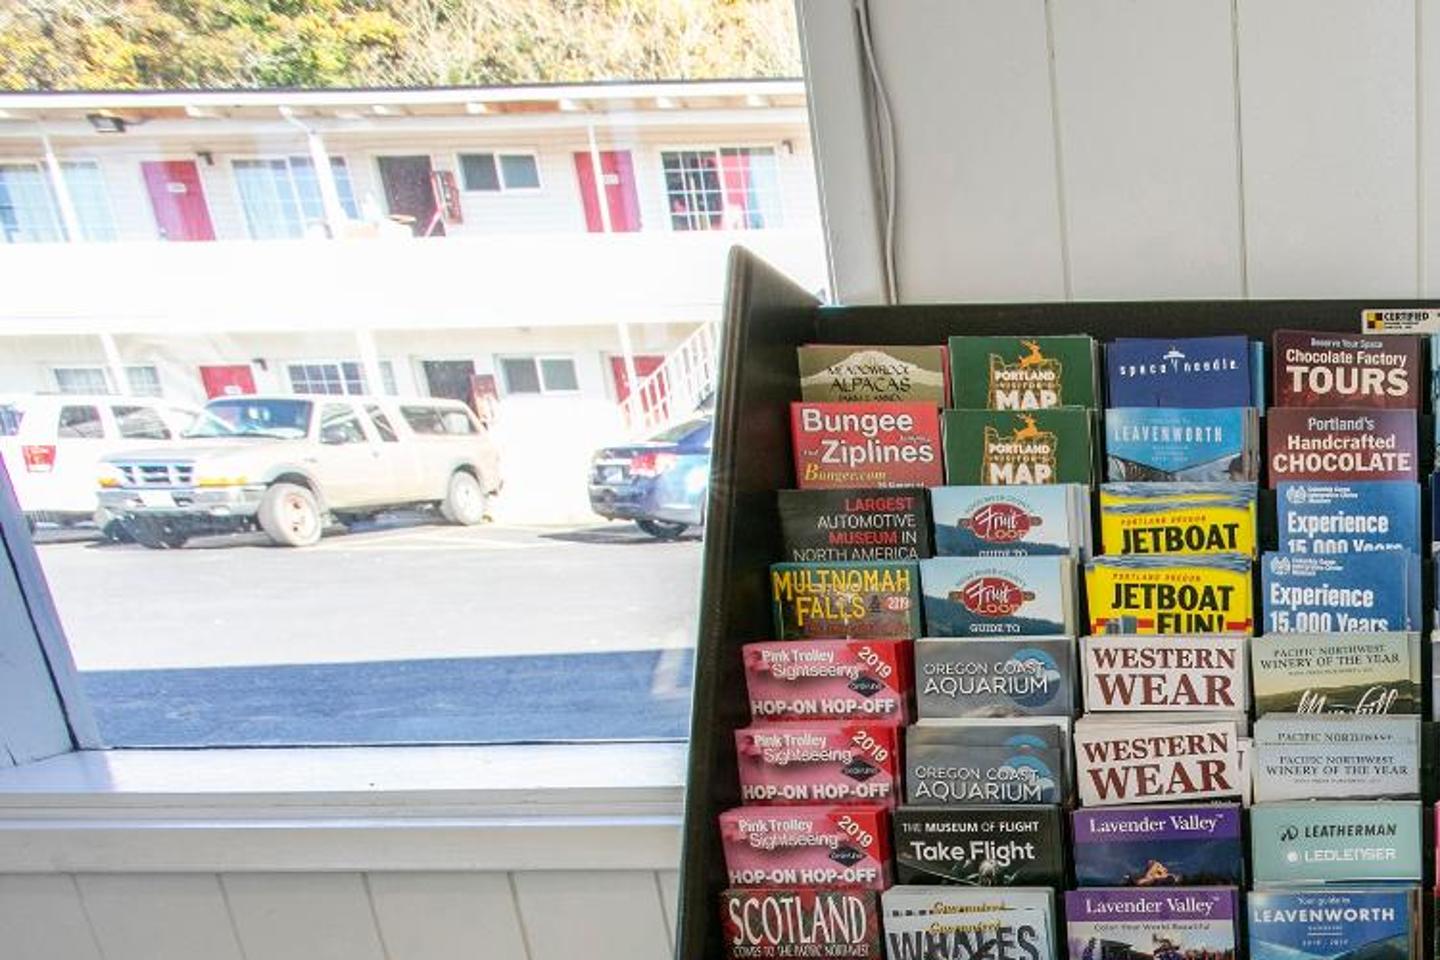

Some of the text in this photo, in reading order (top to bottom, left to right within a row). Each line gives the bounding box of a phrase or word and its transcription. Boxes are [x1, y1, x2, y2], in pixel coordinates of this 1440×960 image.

[1286, 349, 1407, 367] Chocolate Factory
[831, 378, 912, 394] ALPACAS
[1286, 367, 1409, 396] TOURS
[802, 408, 913, 436] Bungee
[1308, 416, 1375, 431] Portland's
[1114, 426, 1222, 443] LEAVENWORTH
[1288, 434, 1395, 450] Handcrafted
[821, 440, 934, 467] Ziplines
[988, 444, 1050, 454] PORTLAND
[1273, 453, 1411, 473] CHOCOLATE
[805, 463, 886, 482] Bungee.com
[990, 464, 1051, 485] MAP
[846, 498, 914, 511] LARGEST
[818, 514, 916, 529] AUTOMOTIVE
[829, 531, 917, 545] MUSEUM IN
[793, 546, 918, 562] NORTH AMERICA
[772, 569, 910, 601] MULTNOMAH
[1111, 583, 1234, 611] JETBOAT
[1270, 583, 1374, 608] Experience
[797, 597, 868, 625] FALLS
[969, 623, 1021, 634] GUIDE TO
[1337, 611, 1389, 632] Years
[762, 650, 834, 664] Pink Trolley
[858, 646, 892, 680] 2019
[1092, 648, 1236, 669] WESTERN
[1260, 653, 1400, 669] WINERY OF THE YEAR
[772, 663, 859, 680] Sightseeing
[923, 661, 1044, 675] OREGON COAST
[923, 678, 1048, 695] AQUARIUM
[1095, 674, 1235, 706] WEAR
[752, 699, 894, 716] HOP-ON HOP-OFF
[902, 821, 1039, 833] THE MUSEUM OF FLIGHT
[1090, 817, 1166, 833] Lavender
[1304, 823, 1397, 839] LEATHERMAN
[911, 841, 1035, 867] Take Flight
[1255, 908, 1396, 923] LEAVENWORTH
